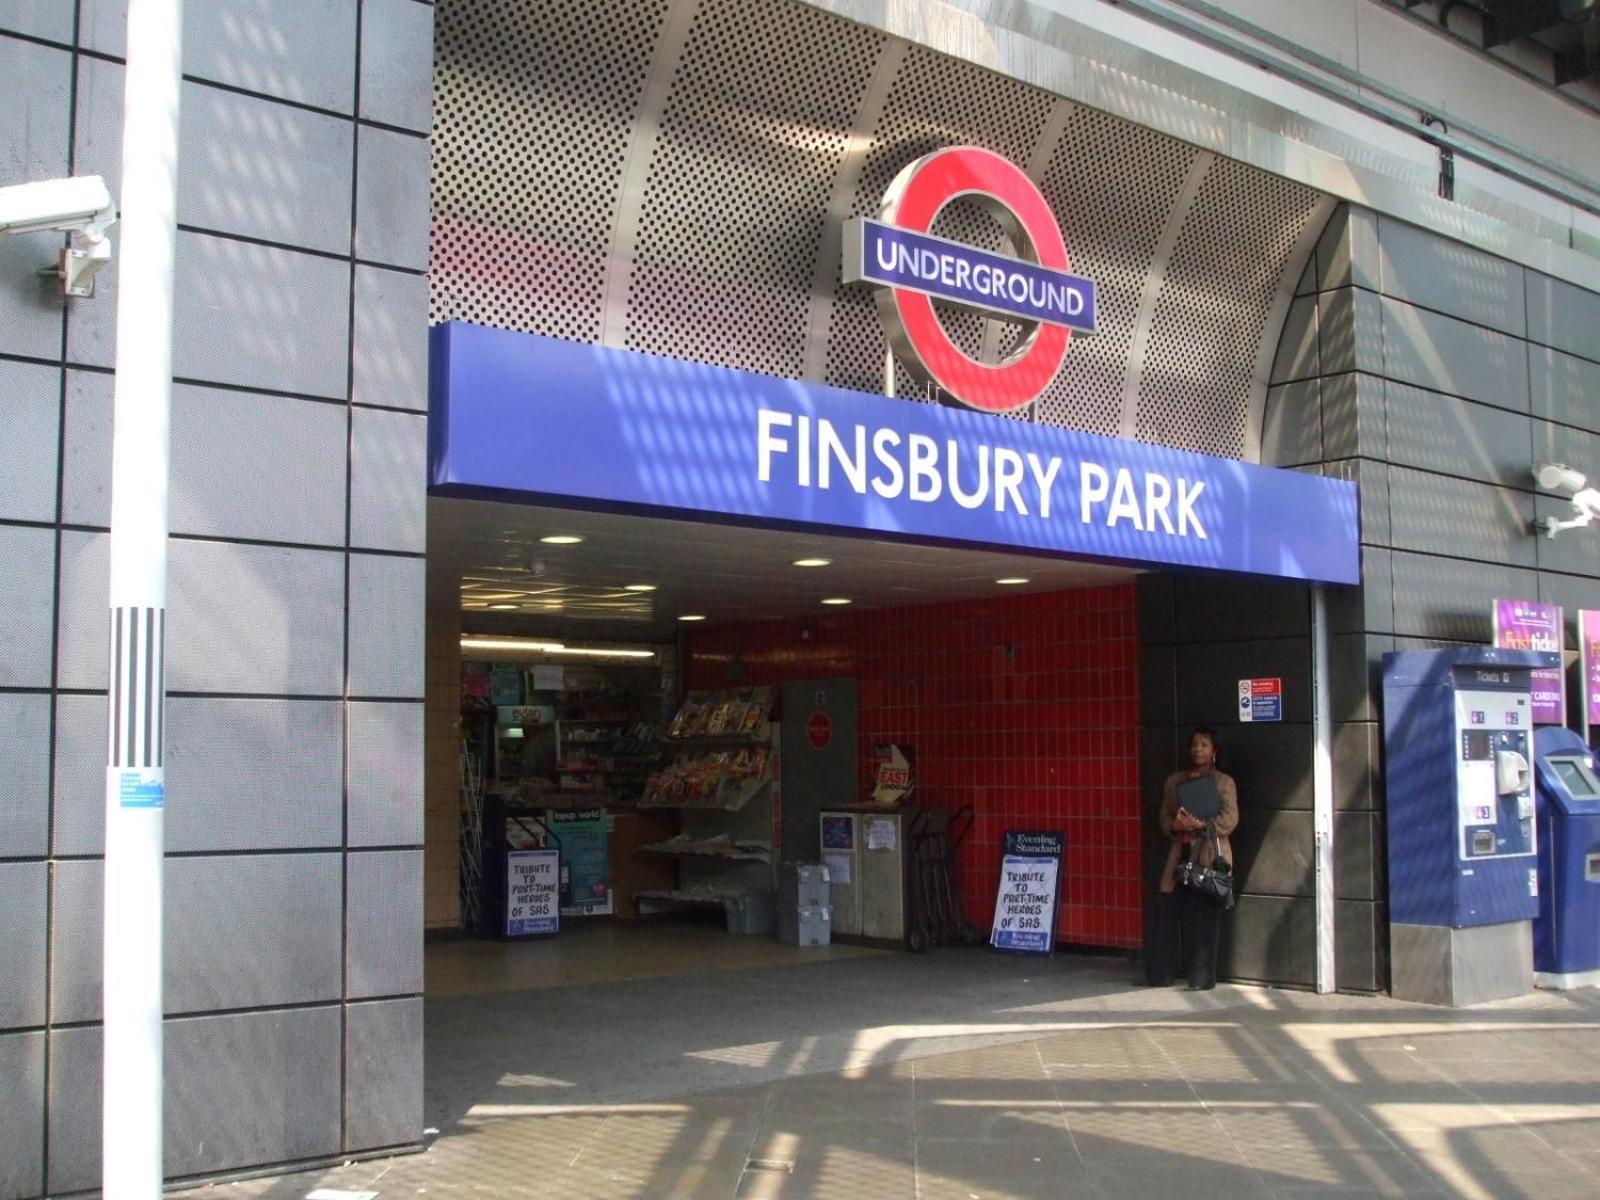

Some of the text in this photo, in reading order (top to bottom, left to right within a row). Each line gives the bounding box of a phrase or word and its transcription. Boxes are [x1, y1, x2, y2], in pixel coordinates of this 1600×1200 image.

[876, 237, 1085, 316] UNDERGROUND
[757, 407, 1209, 540] FINSBURY PARK
[1476, 671, 1500, 682] Tickets
[880, 771, 909, 785] EAST
[1017, 833, 1057, 846] Evening
[1016, 844, 1061, 854] Standard
[513, 864, 551, 875] TRIBUTE
[523, 875, 536, 884] TO
[1007, 872, 1046, 882] TRIBUTE
[1015, 883, 1028, 893] TO
[518, 894, 550, 904] HEROES
[1003, 893, 1050, 904] PART-TIME
[512, 904, 550, 918] OF SAS
[1007, 904, 1042, 915] HEROES
[1001, 917, 1040, 929] OF SAS
